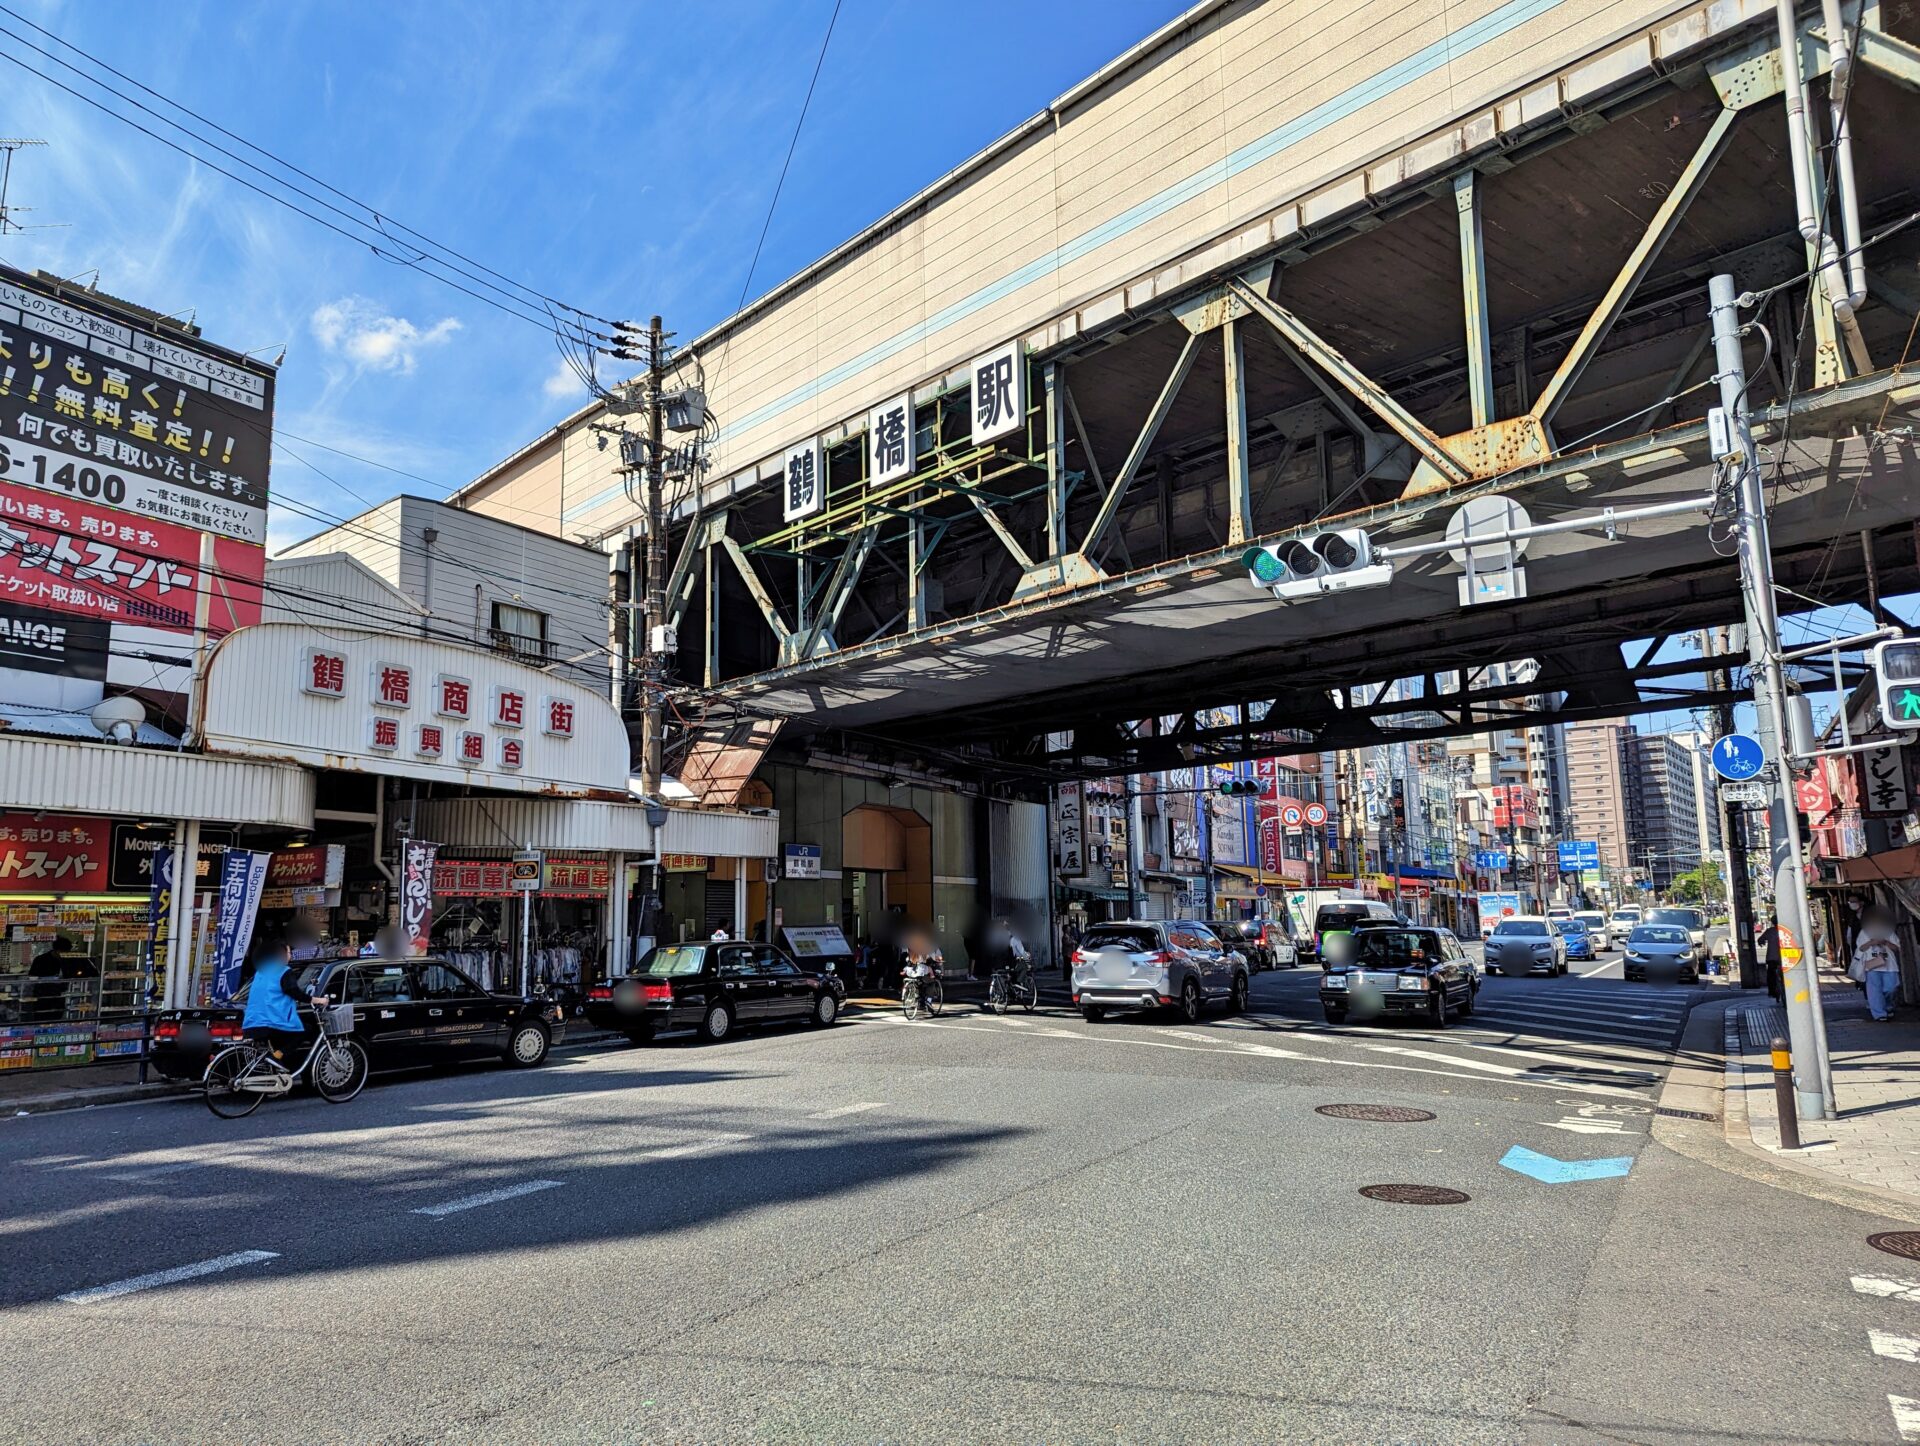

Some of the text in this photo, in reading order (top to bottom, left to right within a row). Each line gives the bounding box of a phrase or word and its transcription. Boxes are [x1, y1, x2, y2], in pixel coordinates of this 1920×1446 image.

[0, 286, 123, 341] いものでも大歓迎！
[34, 321, 77, 341] パソコン
[143, 337, 258, 390] 壊れていても大丈夫！
[164, 366, 198, 386] 家電品
[788, 353, 1015, 512] 鶴橋駅
[17, 411, 257, 501] 何でも買取いたします。
[0, 497, 159, 548] います。売ります。
[136, 498, 256, 538] お気軽にお電話ください。
[146, 487, 249, 521] 一度ご相談ください！
[312, 653, 574, 734] 鶴橋商店街
[375, 720, 522, 764] 振興組合
[1309, 809, 1323, 820] 50
[1727, 792, 1760, 800] ここから
[168, 840, 225, 854] EANGE
[798, 846, 809, 856] JR
[1061, 803, 1081, 870] 正宗屋
[1263, 820, 1277, 873] BIG ECHO
[0, 850, 99, 879] トスーパー
[435, 867, 513, 891] 流通革
